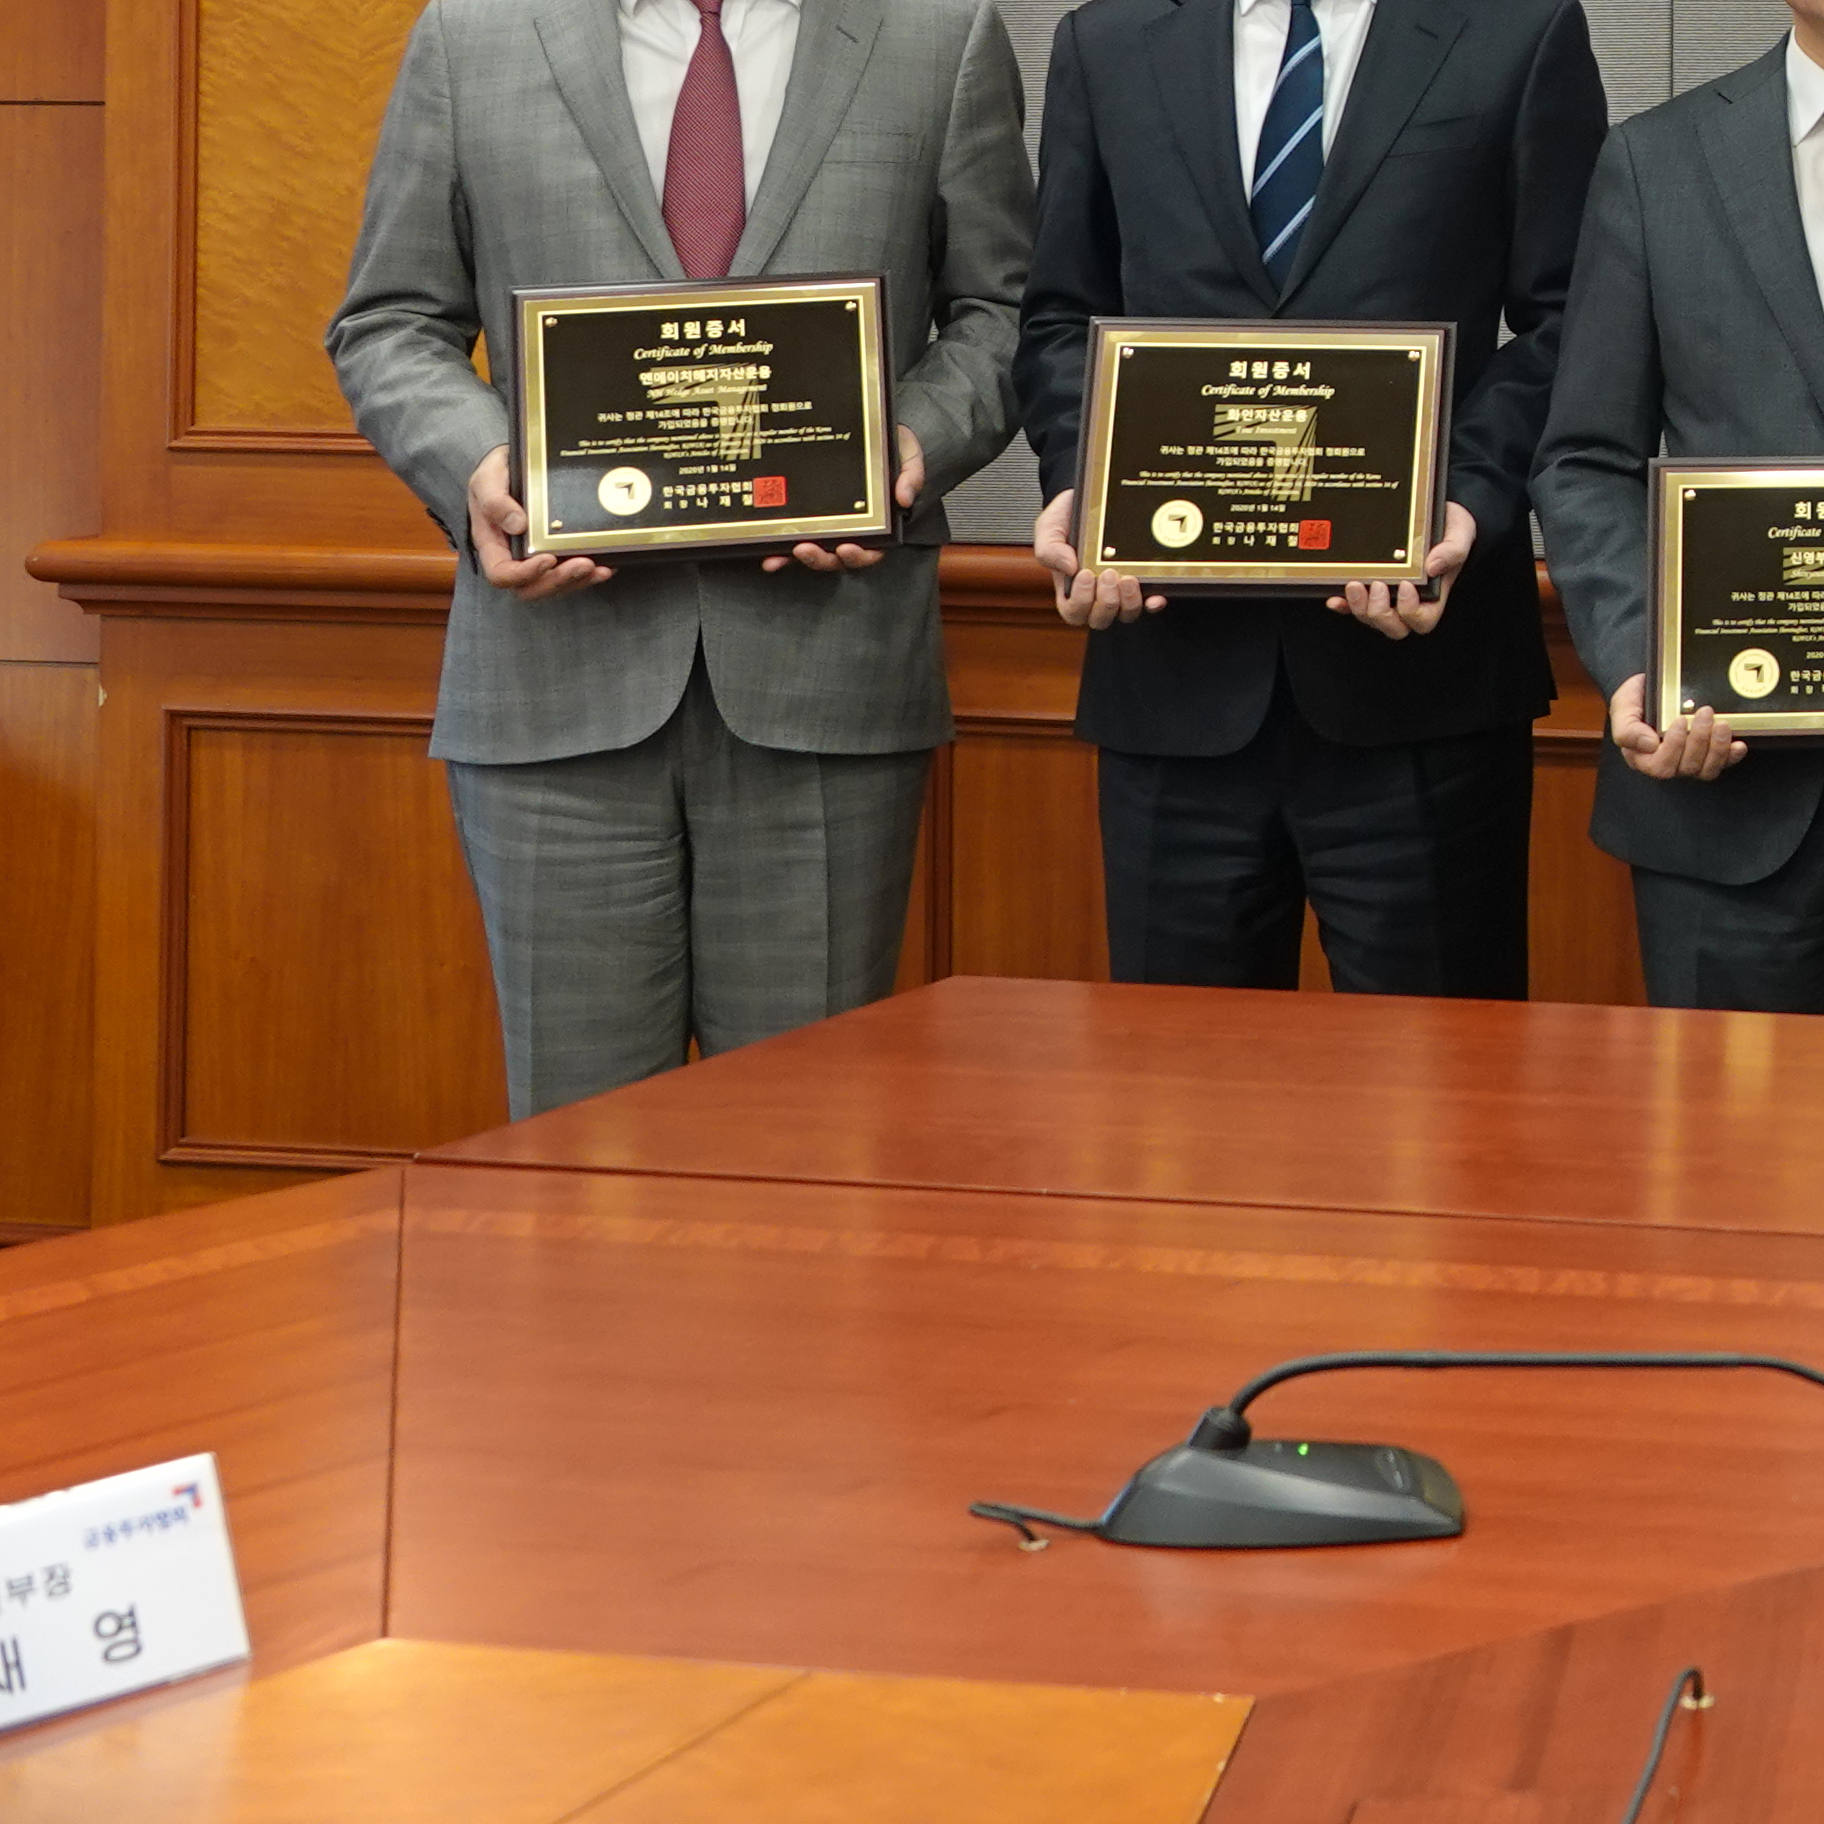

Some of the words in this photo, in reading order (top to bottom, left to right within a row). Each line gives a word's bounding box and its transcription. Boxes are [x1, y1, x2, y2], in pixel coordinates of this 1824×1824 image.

[659, 317, 746, 341] 회원증서
[632, 344, 691, 362] Certificate
[691, 342, 709, 359] of
[707, 339, 774, 358] Membership
[1228, 359, 1311, 380] 회원증서
[1200, 383, 1256, 399] Certificate
[1256, 383, 1273, 398] of
[1271, 383, 1336, 400] Membership
[1226, 407, 1308, 423] 화인자산운용
[661, 479, 753, 498] 한국금융투자협회
[1766, 525, 1822, 541] Certificate
[0, 1562, 73, 1609] 부장
